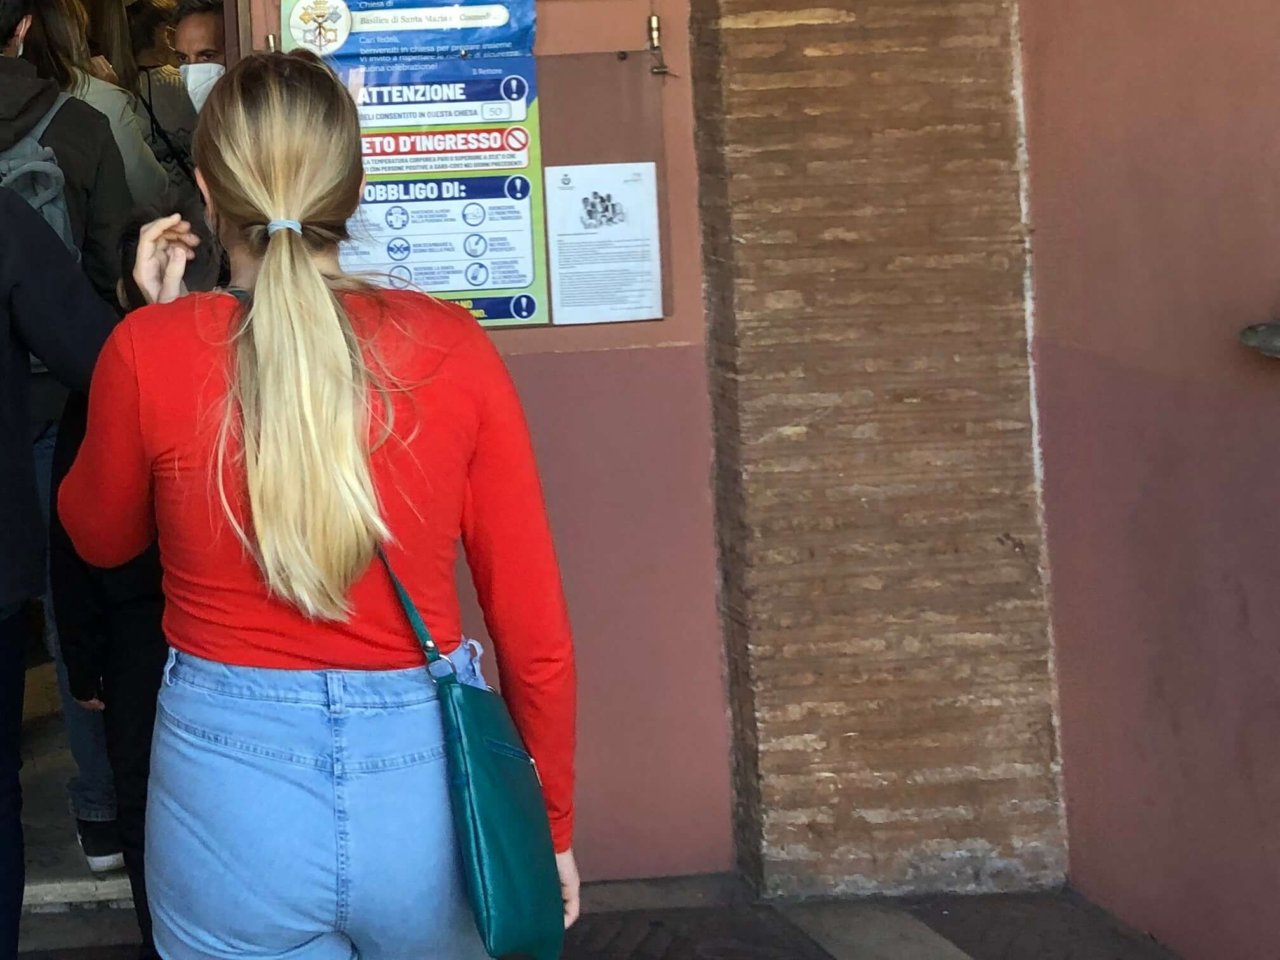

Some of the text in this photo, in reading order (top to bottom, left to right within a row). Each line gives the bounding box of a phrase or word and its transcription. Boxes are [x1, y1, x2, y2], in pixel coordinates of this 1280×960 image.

[357, 83, 466, 105] ATTENZIONE
[399, 132, 501, 152] D'INGRESSO
[364, 181, 467, 201] OBBLIGO DI:
